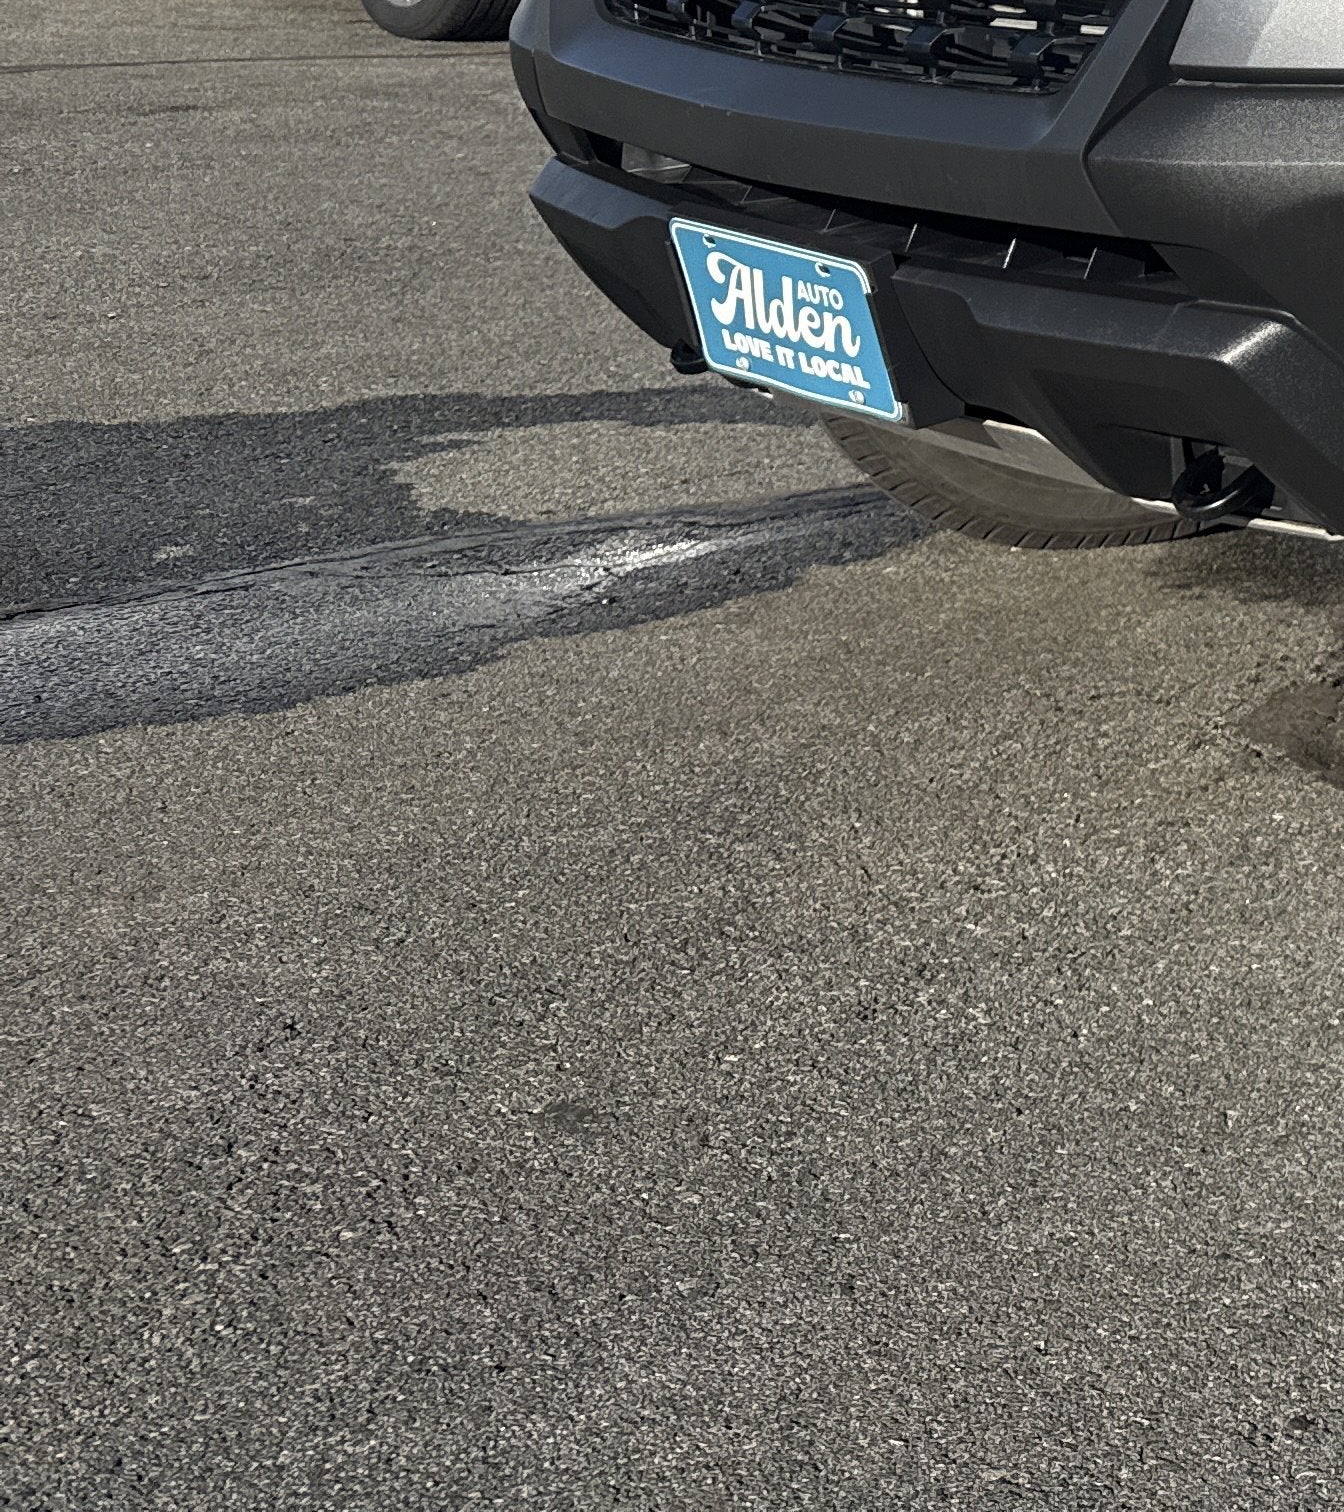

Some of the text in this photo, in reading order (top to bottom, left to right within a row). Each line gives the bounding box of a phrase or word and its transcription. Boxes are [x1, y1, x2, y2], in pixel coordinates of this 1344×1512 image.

[706, 251, 861, 358] Alden
[797, 279, 844, 311] AUTO
[722, 328, 871, 390] LOVE IT LOCAL
